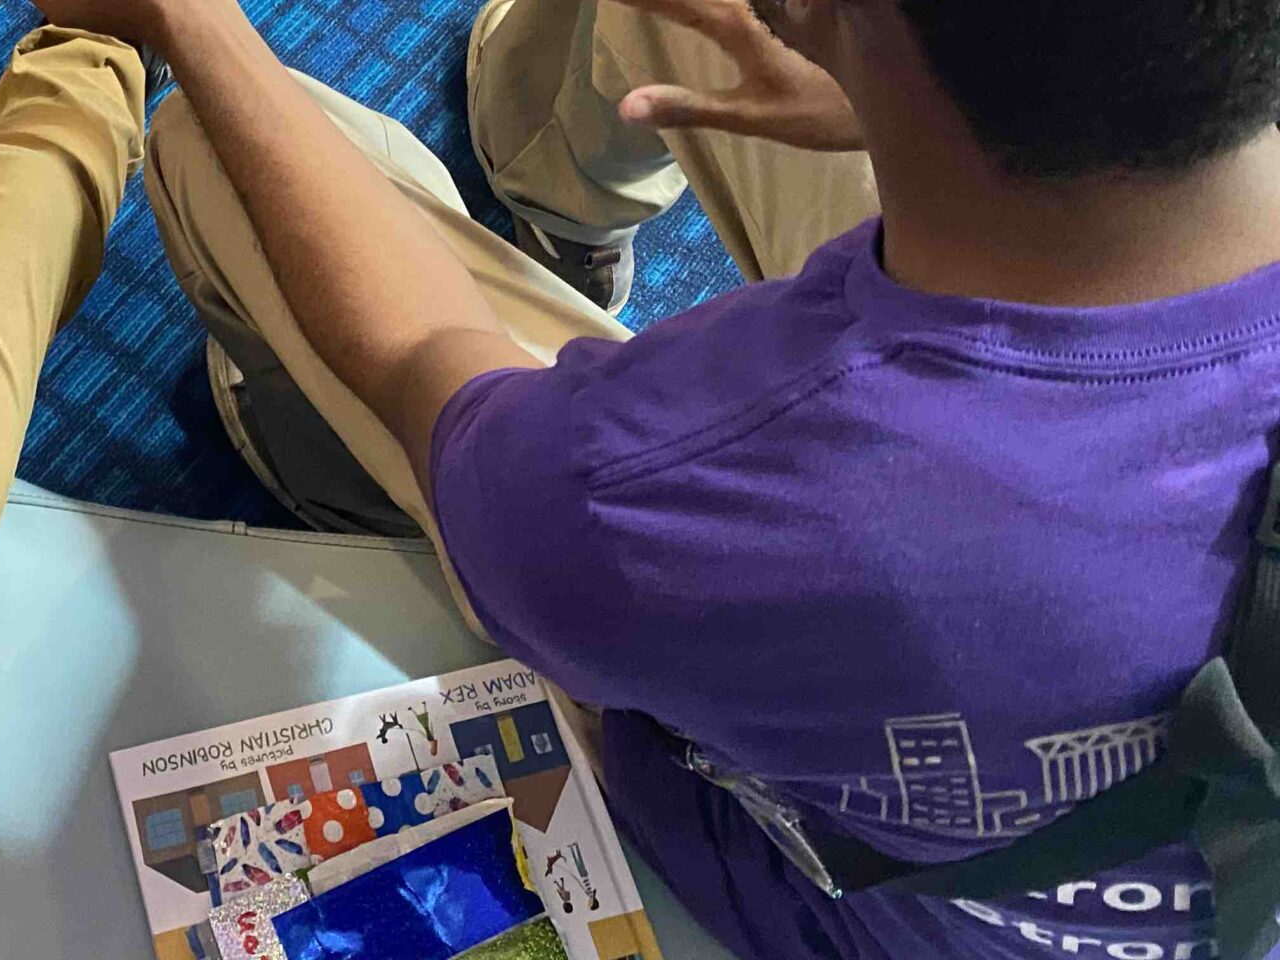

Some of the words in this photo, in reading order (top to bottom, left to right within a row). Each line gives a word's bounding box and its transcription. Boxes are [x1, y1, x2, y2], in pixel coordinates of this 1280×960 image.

[482, 669, 536, 696] ADAM
[439, 683, 479, 706] REX
[493, 693, 527, 708] story
[474, 701, 492, 713] by
[240, 716, 333, 754] CHRISTIAN
[141, 742, 233, 777] ROBINSON
[220, 762, 238, 773] by
[240, 745, 294, 769] pictures
